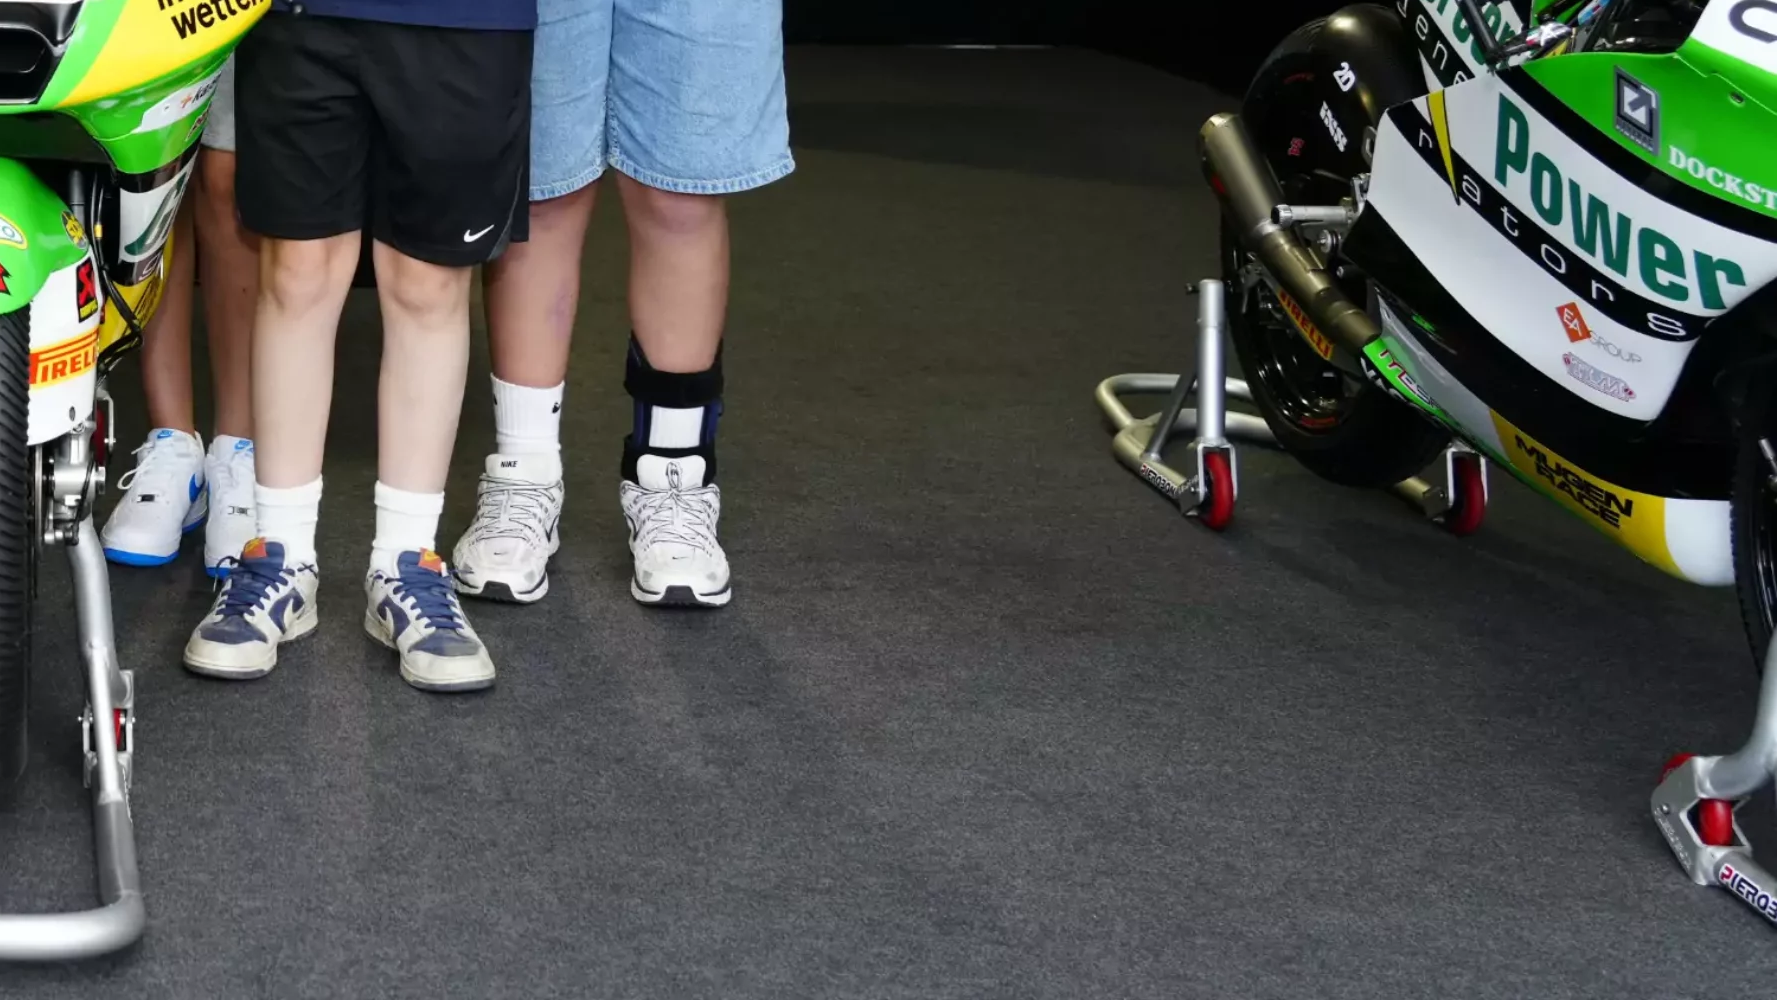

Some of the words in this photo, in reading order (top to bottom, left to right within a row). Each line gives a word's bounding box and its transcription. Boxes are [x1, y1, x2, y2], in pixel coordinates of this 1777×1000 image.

[1494, 93, 1746, 310] Power
[1669, 145, 1777, 211] DOCKST
[500, 460, 519, 469] NIKE
[1515, 434, 1634, 518] MUGEN
[1534, 460, 1621, 530] RACE
